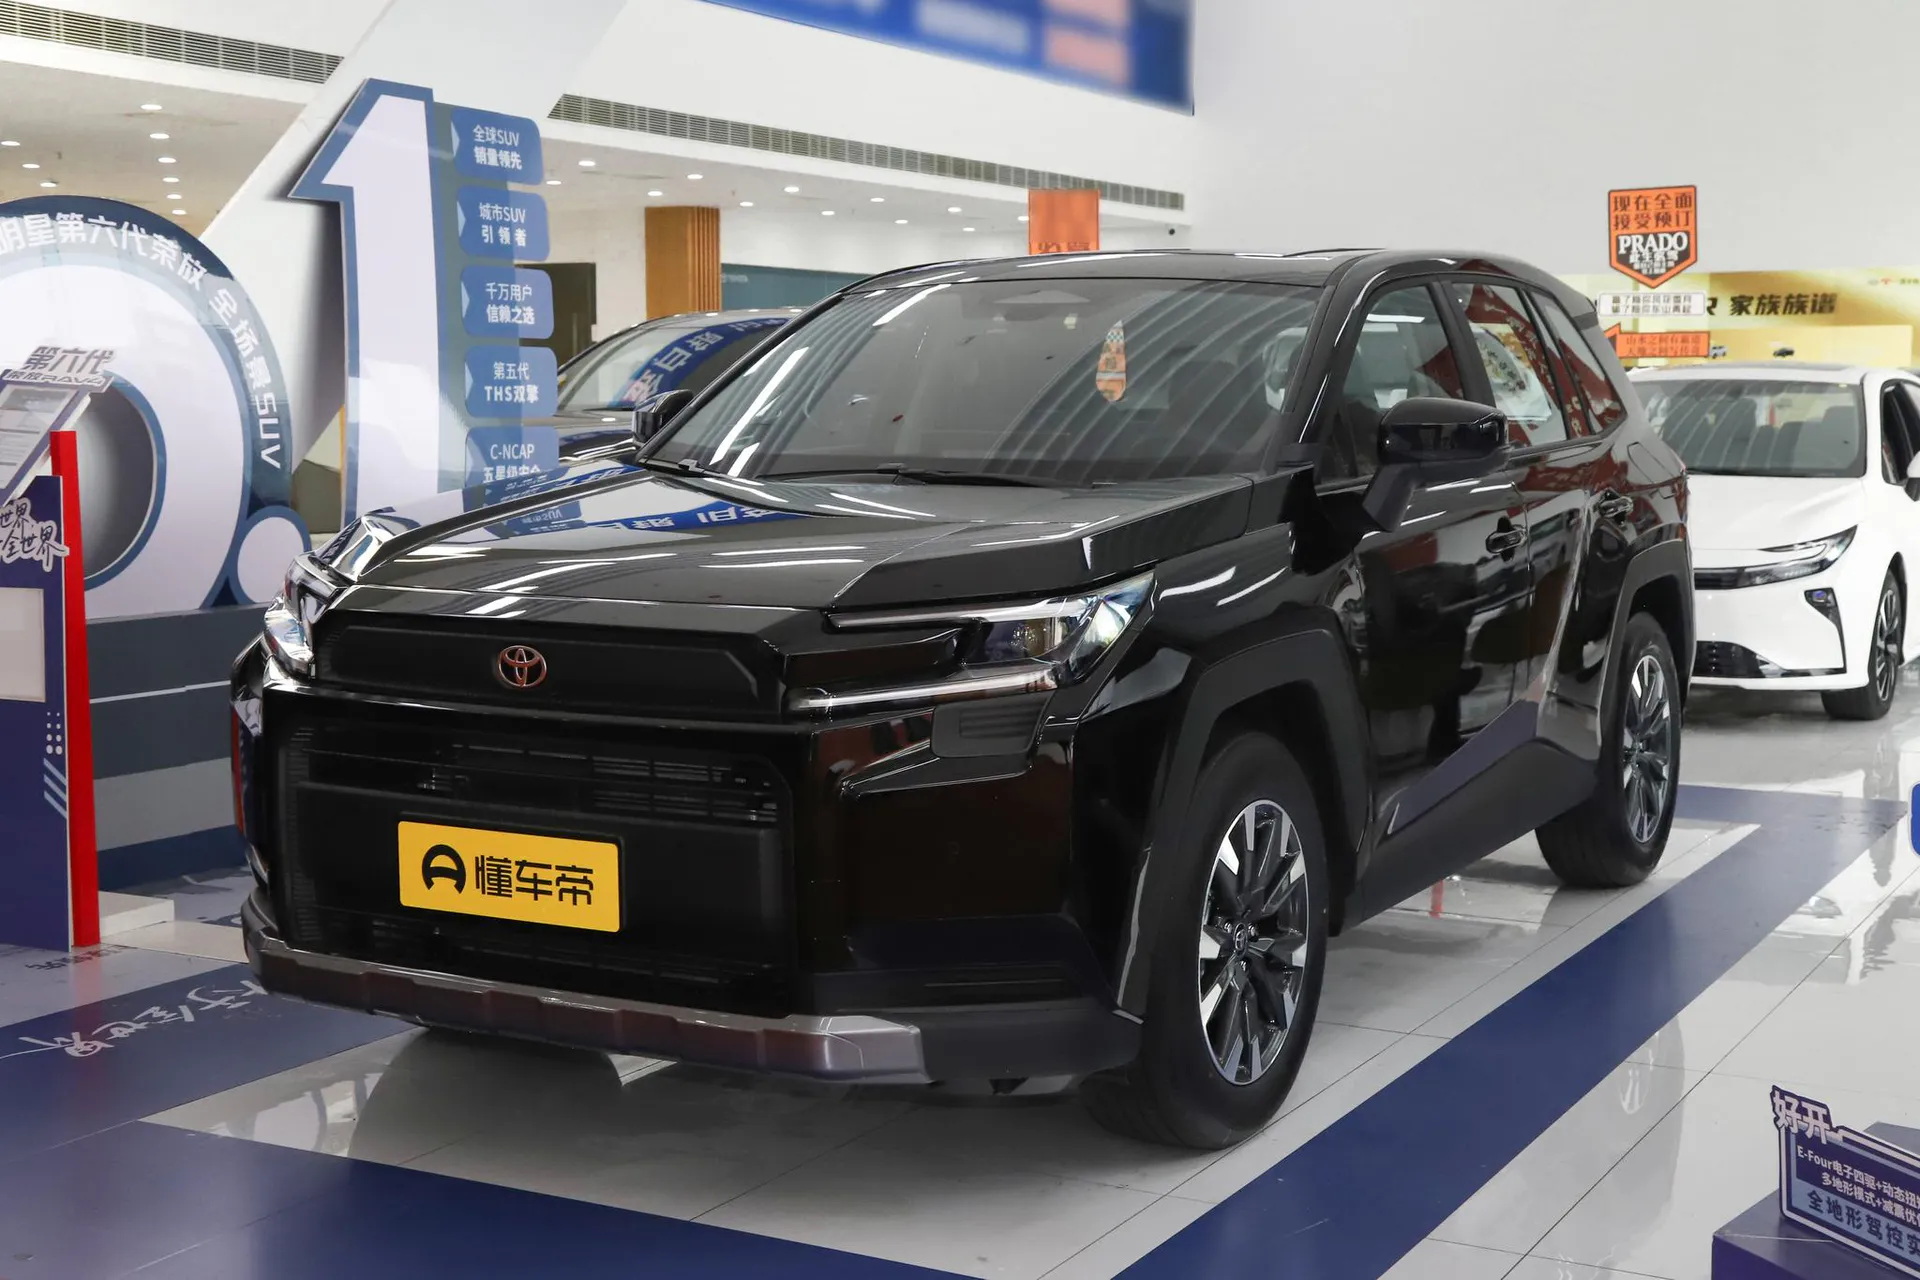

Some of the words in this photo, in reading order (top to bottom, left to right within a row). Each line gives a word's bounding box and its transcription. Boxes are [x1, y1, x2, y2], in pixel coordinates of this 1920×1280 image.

[473, 124, 520, 147] 全球SUV
[474, 146, 523, 170] 销量领先
[479, 202, 526, 224] 城市SUV
[1614, 193, 1692, 212] 现在全面
[1614, 210, 1690, 230] 接受预订
[1618, 231, 1688, 255] PRADO
[485, 282, 532, 302] 千万用户
[486, 304, 535, 325] 信赖之选
[1729, 293, 1837, 316] 家族族谱
[22, 346, 115, 374] 第六代
[493, 362, 530, 380] 第五代
[484, 385, 539, 403] THS双擎
[490, 444, 535, 460] C-NCAP
[475, 855, 593, 906] 懂车帝
[1773, 1090, 1829, 1145] 好开
[1797, 1145, 1920, 1211] E-Four电子四驱+动态扭
